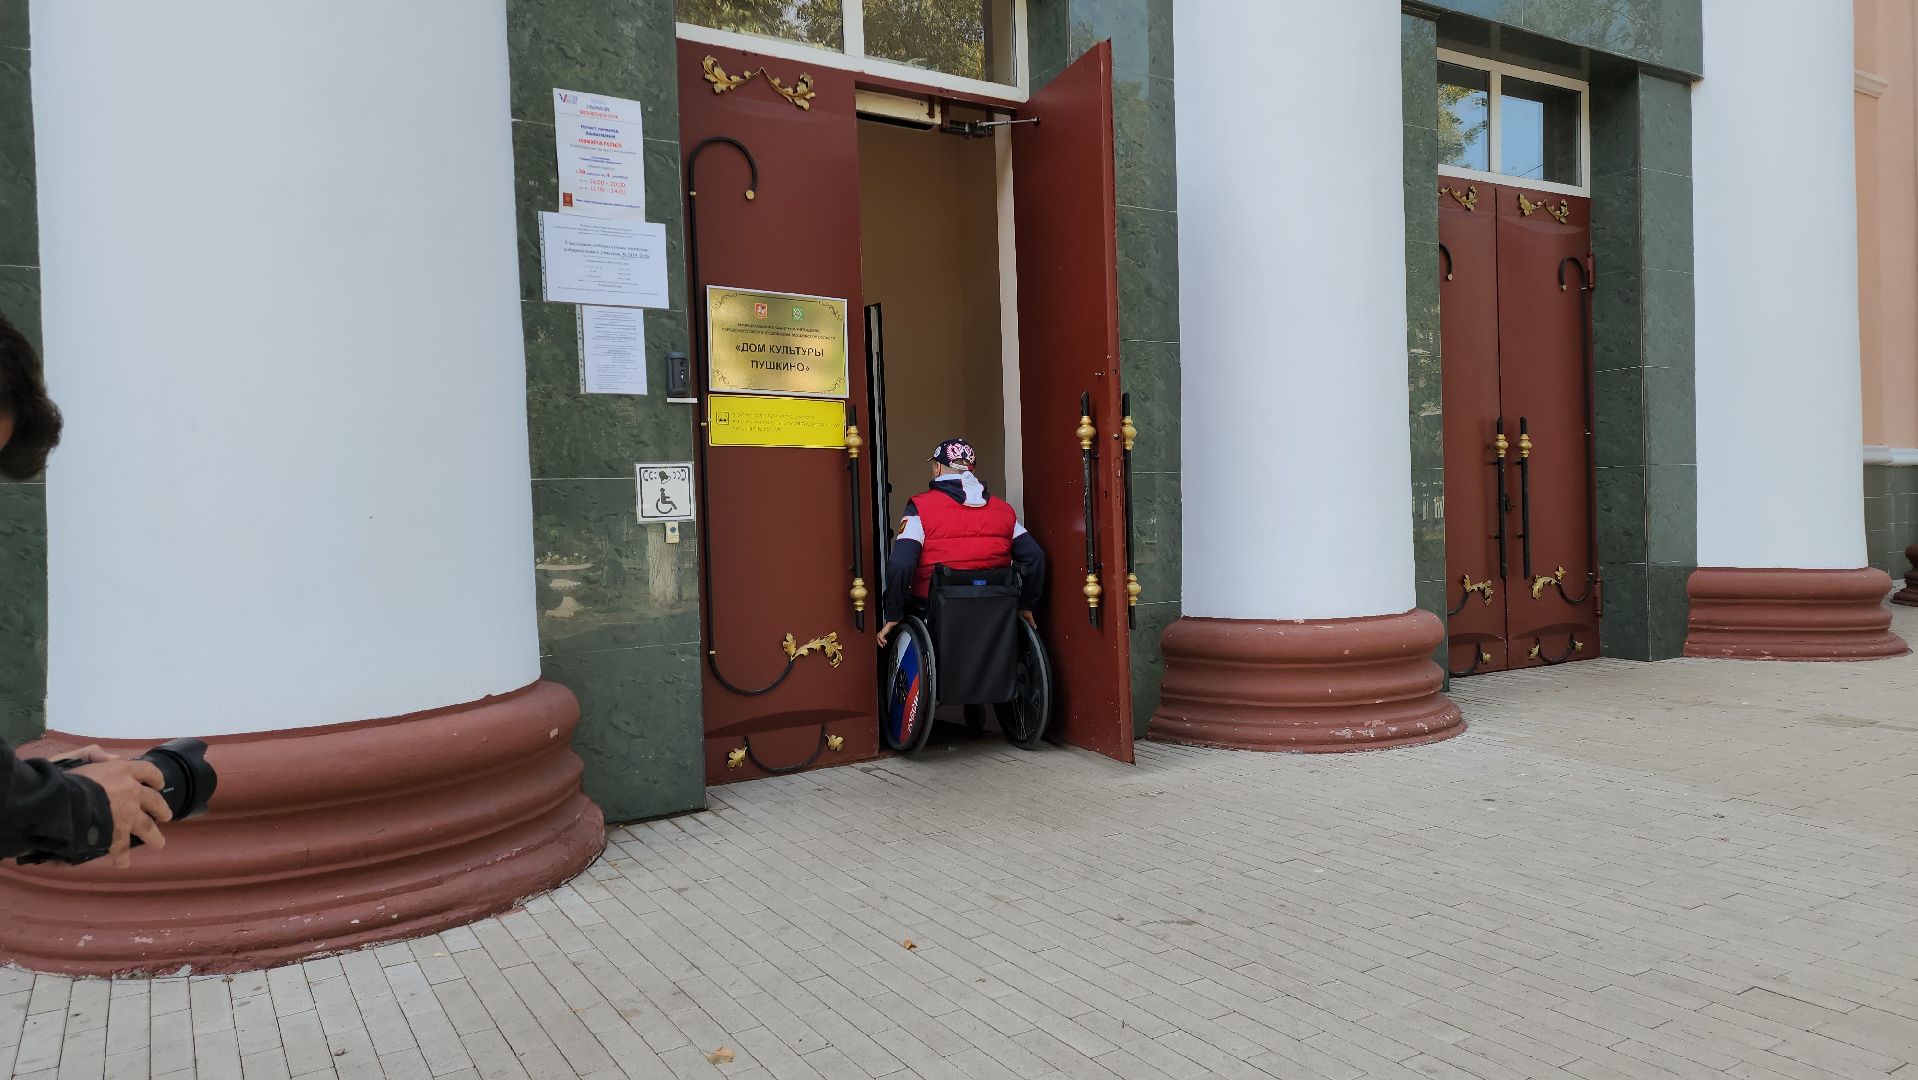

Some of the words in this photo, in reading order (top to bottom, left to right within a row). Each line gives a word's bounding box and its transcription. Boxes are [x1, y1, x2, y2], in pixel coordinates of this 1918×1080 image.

[735, 342, 766, 353] «ДОМ
[769, 344, 824, 357] КУЛЬТУРЫ
[750, 359, 810, 371] ПУШКИНО»
